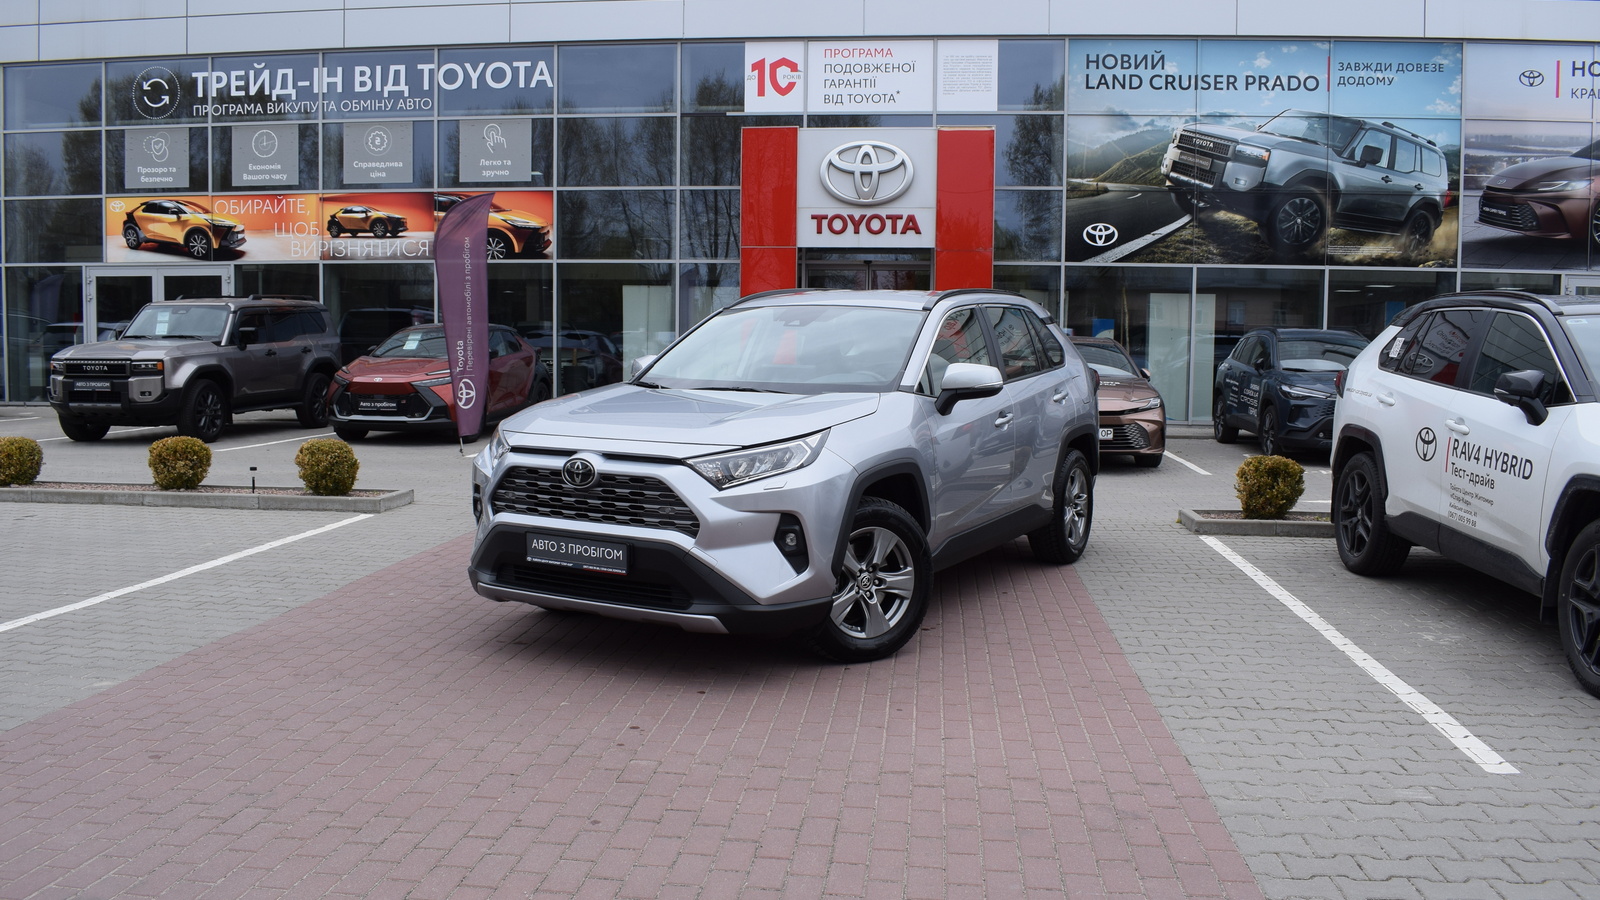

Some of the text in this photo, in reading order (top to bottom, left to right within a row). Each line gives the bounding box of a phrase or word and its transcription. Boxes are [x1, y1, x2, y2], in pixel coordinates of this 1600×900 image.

[824, 48, 894, 58] ПРОГРАМА
[1086, 50, 1165, 70] НОВИЙ
[824, 60, 916, 75] ПОДОВЖЕНОЇ
[1337, 62, 1444, 74] ЗАВЖДИ ДОВЕЗЕ
[192, 61, 554, 101] ТРЕЙД-ІН ВІД TOYOTA
[824, 76, 877, 88] ГАРАНТІЇ
[1085, 74, 1320, 92] LAND CRUISER PRADO
[1337, 76, 1395, 87] ДОДОМУ
[823, 94, 844, 106] ВІД
[1571, 88, 1600, 99] КРА
[193, 98, 432, 116] ПРОГРАМА ВИКУПУ ТА ОБМІНУ АВТО
[1193, 138, 1213, 148] TOYOTA
[137, 166, 168, 175] Прозоро
[353, 161, 403, 169] Справедлива
[480, 159, 502, 167] Легко
[482, 169, 509, 177] зручно
[214, 196, 310, 216] ОБИРАЙТЕ,
[274, 222, 320, 239] ЩОБ
[811, 213, 922, 235] TOYOTA
[291, 239, 429, 257] ВИРІЗНЯТИСЯ
[463, 237, 472, 274] пробігом
[463, 282, 472, 325] автомобілі
[456, 340, 465, 372] Toyota
[466, 326, 474, 371] Перевірені
[1452, 438, 1533, 480] RAV4 HYBRID
[1451, 462, 1495, 490] Тест-драйв
[1449, 482, 1494, 506] Тойота Центр Житомир
[531, 539, 623, 561] АВТО З ПРОБІГОМ
